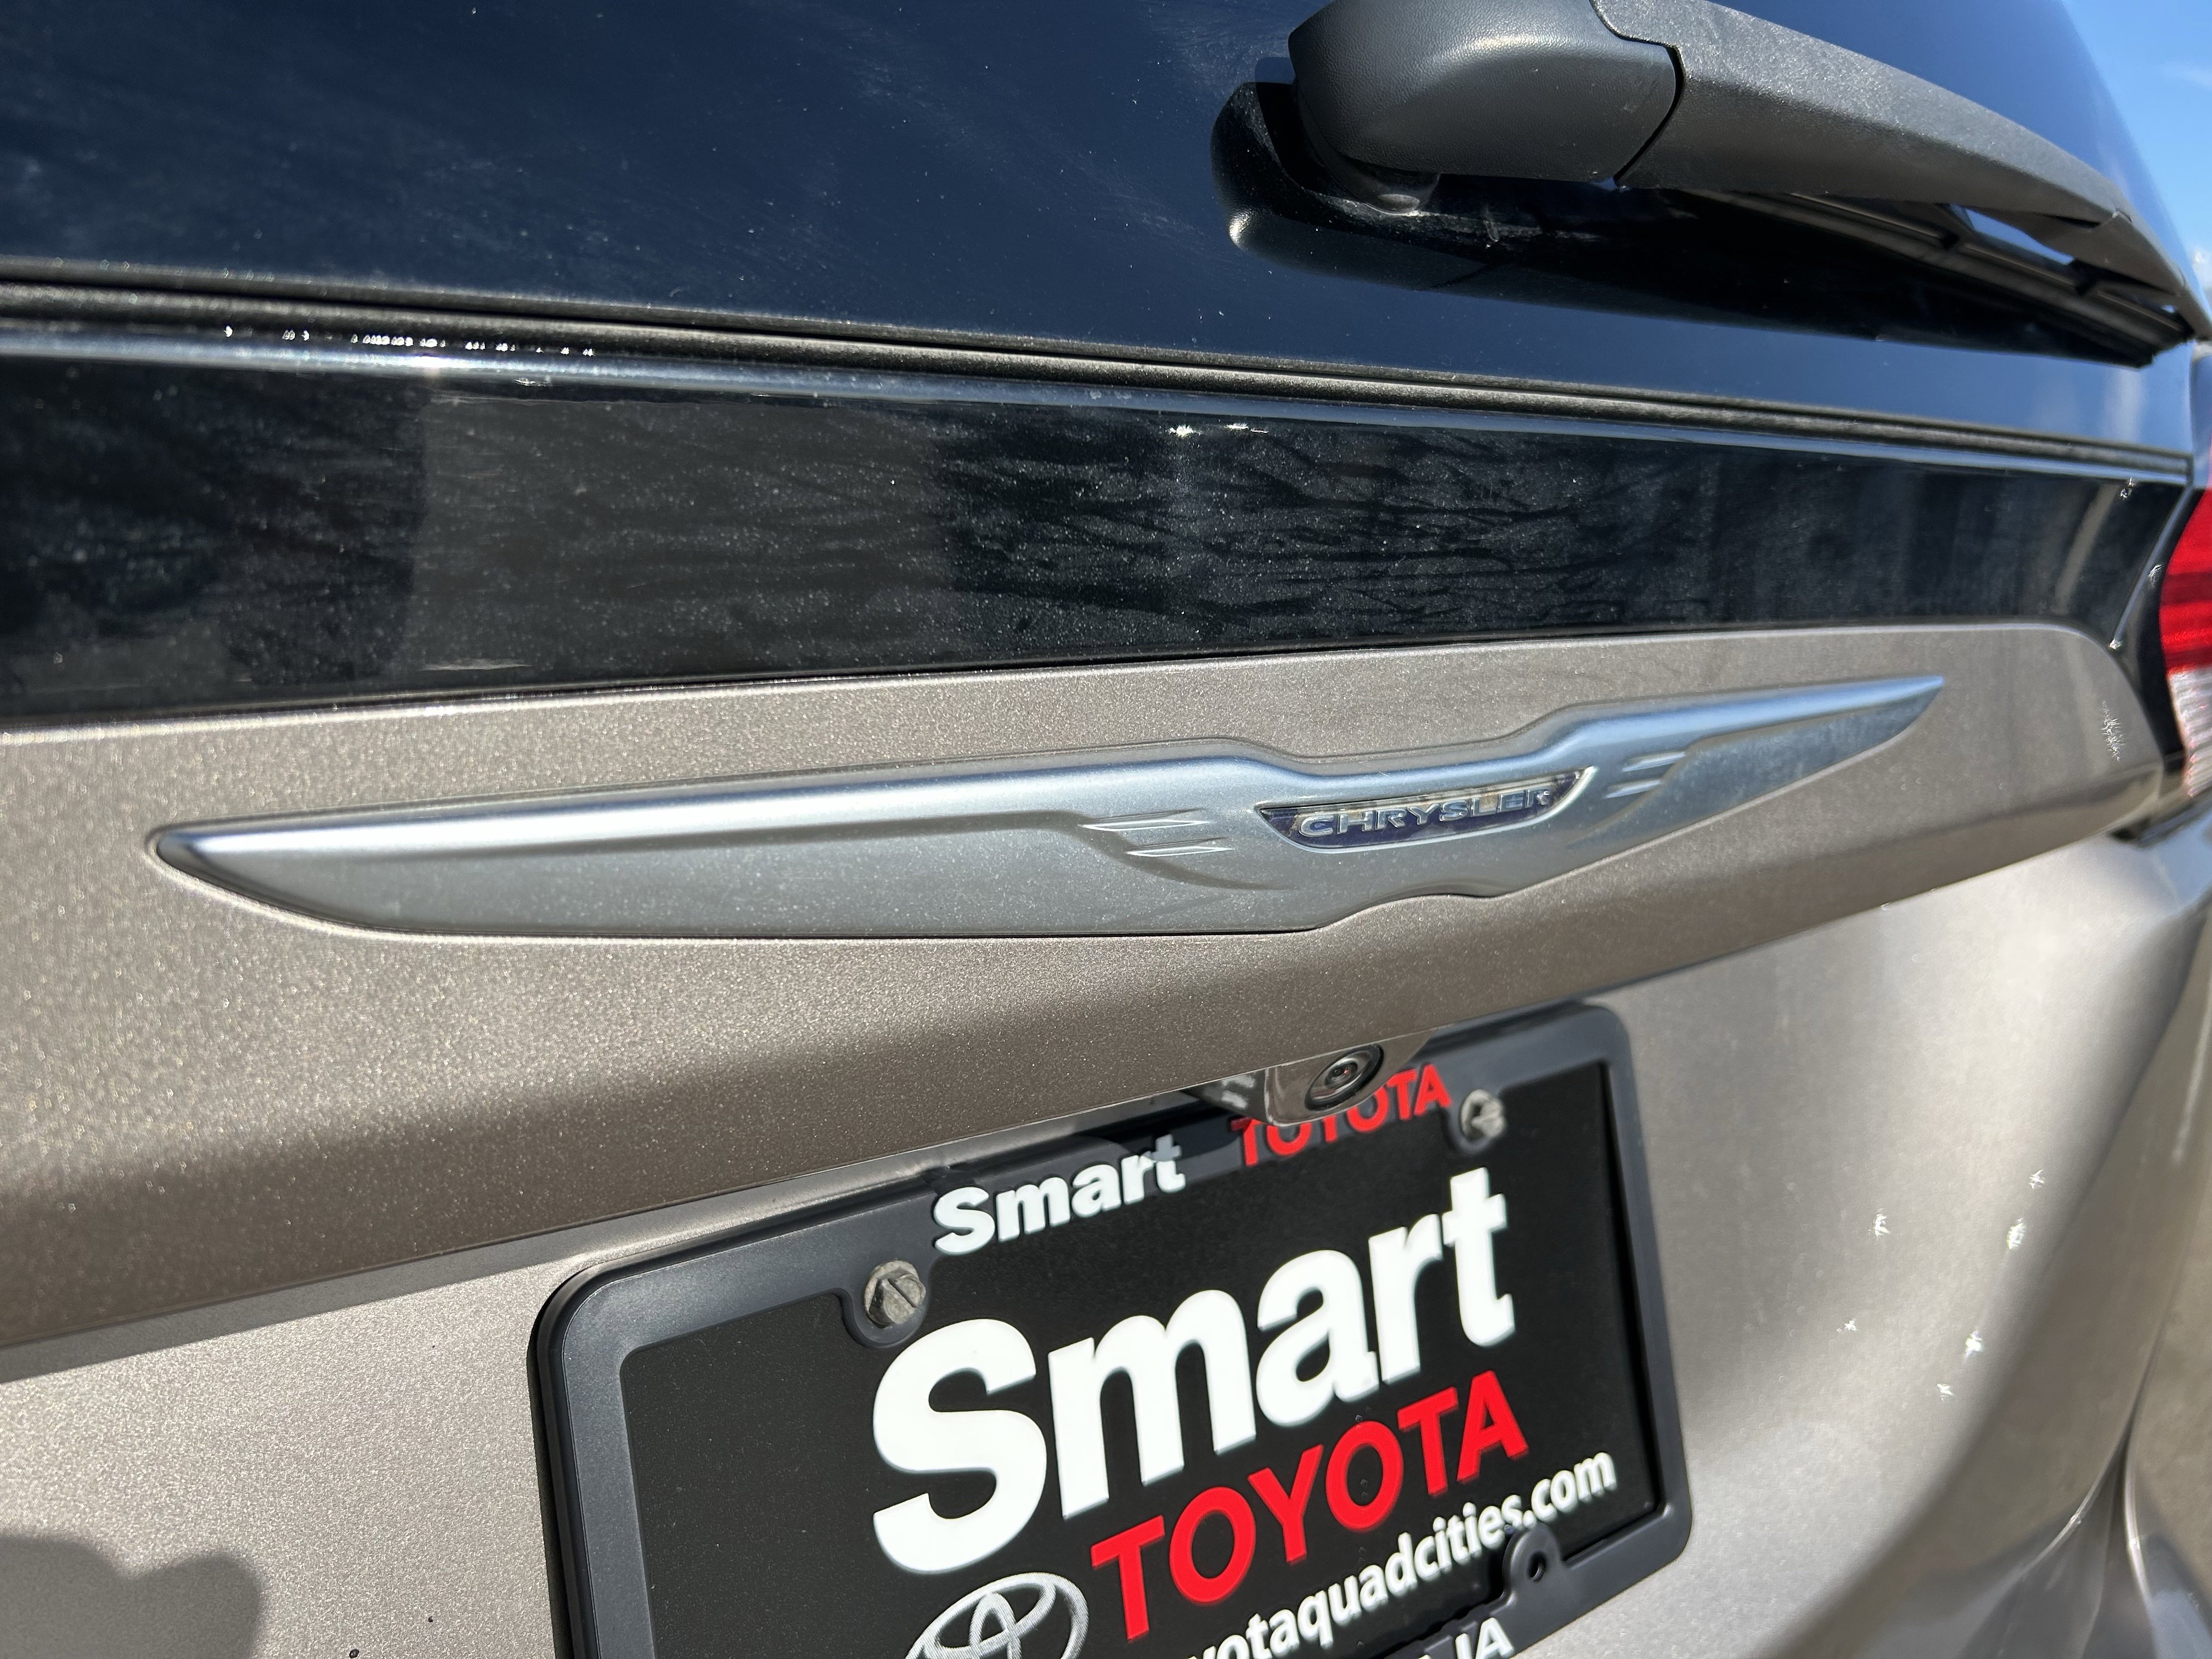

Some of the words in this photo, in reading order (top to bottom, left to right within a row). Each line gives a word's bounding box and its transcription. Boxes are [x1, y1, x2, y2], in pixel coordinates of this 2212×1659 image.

[1299, 787, 1550, 837] CHRYSLER
[933, 1134, 1186, 1255] Smart
[873, 1166, 1516, 1575] Smart
[1091, 1370, 1528, 1642] TOYOTA
[1187, 1451, 1615, 1659] otaquadcities.com
